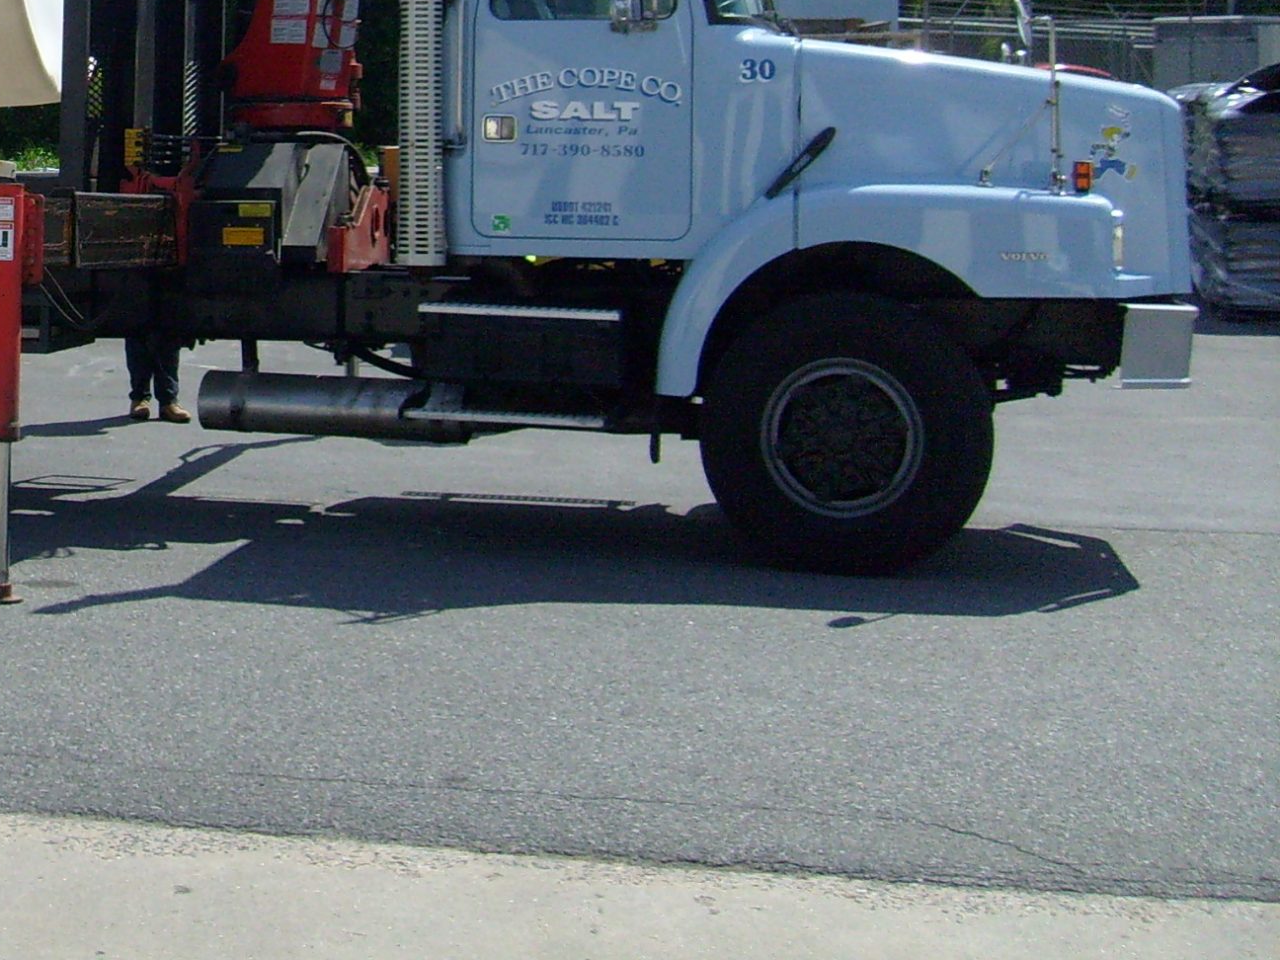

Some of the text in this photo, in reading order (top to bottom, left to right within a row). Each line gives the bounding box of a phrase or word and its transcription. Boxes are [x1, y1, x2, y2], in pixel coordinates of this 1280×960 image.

[740, 58, 776, 82] 30
[491, 71, 554, 103] THE
[557, 67, 637, 91] COPE
[529, 100, 640, 121] SALT
[525, 124, 609, 137] Lancaster,
[519, 142, 646, 158] 717-390-8580
[1000, 251, 1050, 261] VOLVO
